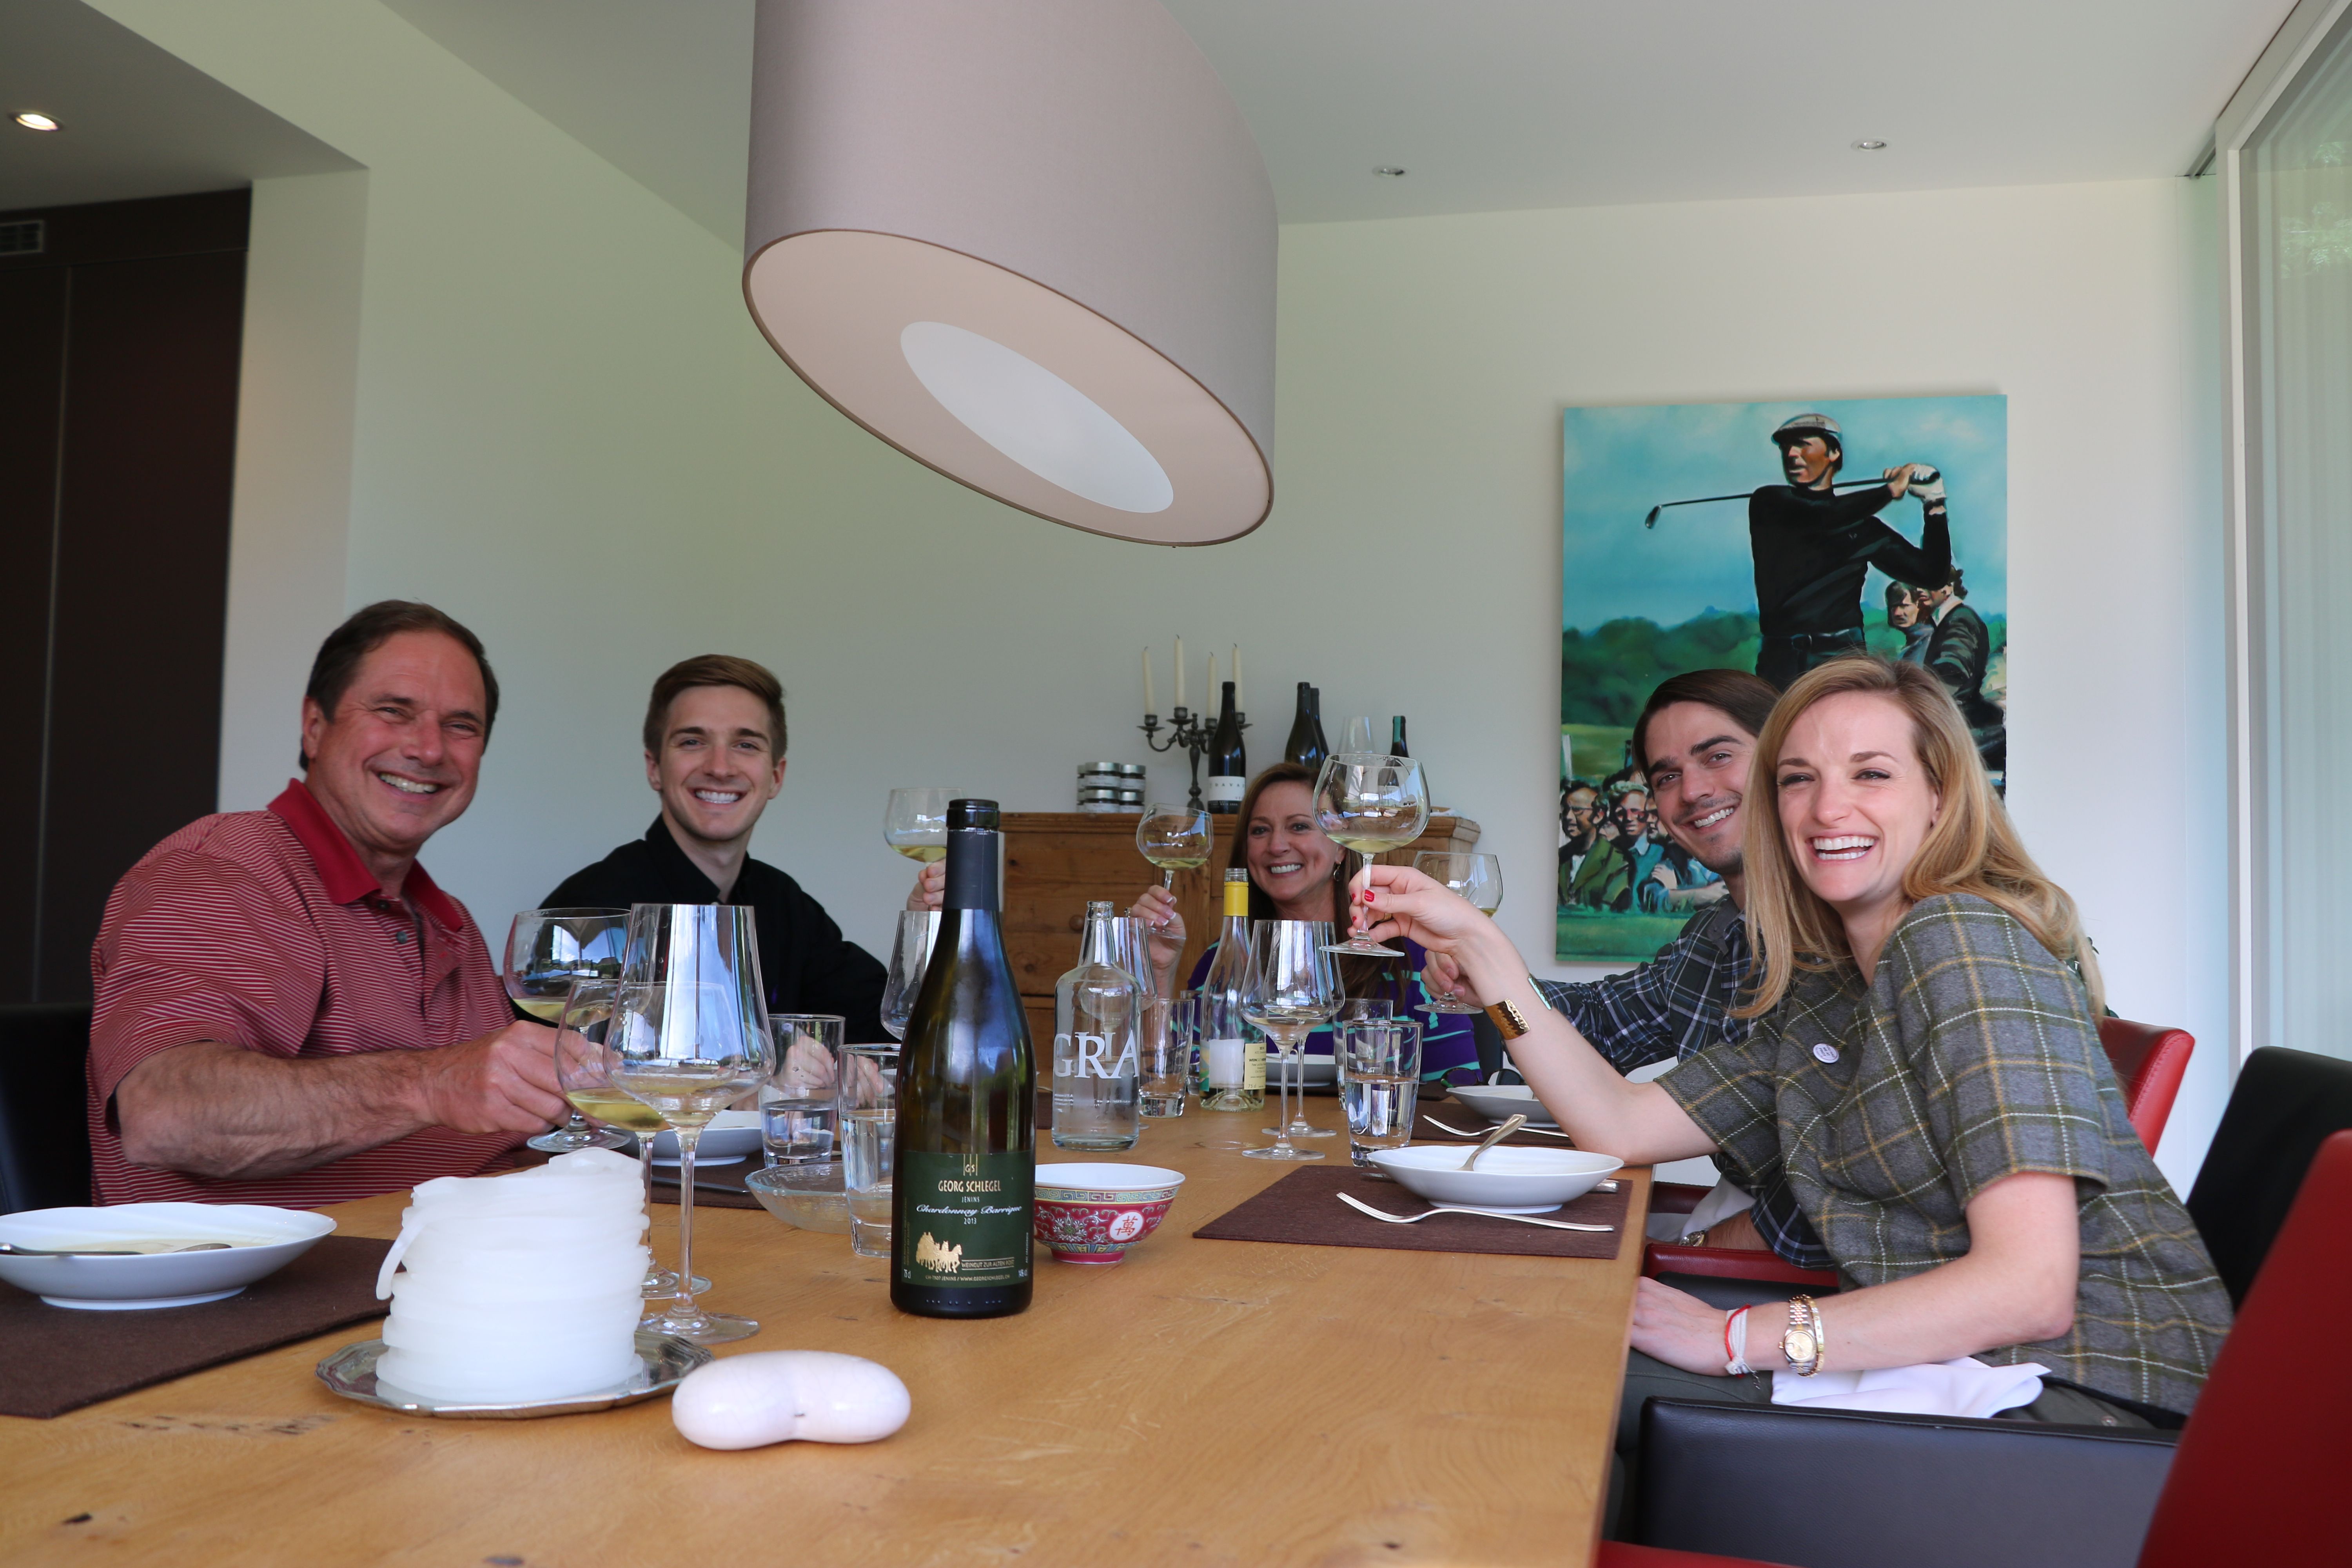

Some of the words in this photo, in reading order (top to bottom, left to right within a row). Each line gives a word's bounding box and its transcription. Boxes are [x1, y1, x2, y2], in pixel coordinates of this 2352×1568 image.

[938, 1180, 964, 1192] GEORG
[966, 1180, 1001, 1192] SCHLEGEL
[916, 1204, 979, 1217] Chardonnay
[980, 1205, 1022, 1215] Barrique
